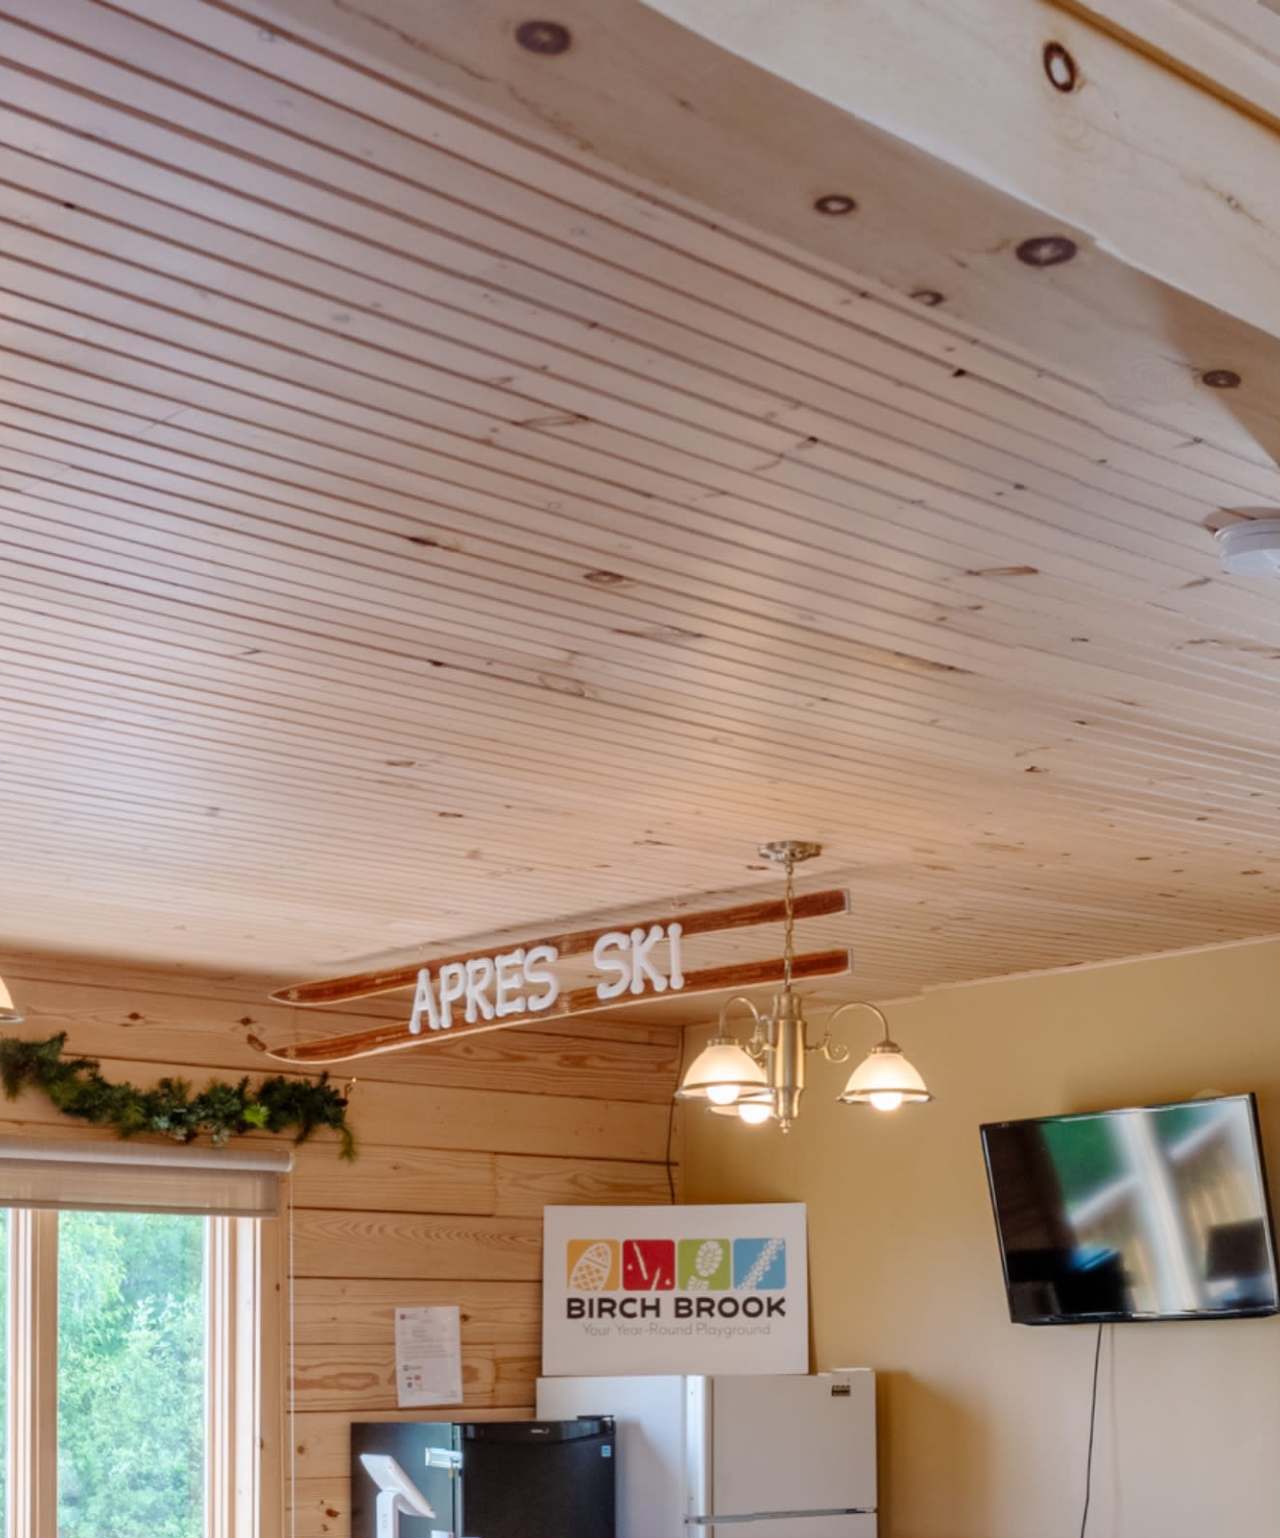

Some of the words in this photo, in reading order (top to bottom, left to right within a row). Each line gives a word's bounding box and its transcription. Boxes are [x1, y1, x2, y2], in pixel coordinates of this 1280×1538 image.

[409, 945, 559, 1034] APRES
[593, 922, 684, 1000] SKI
[566, 1297, 661, 1319] BIRCH
[673, 1296, 786, 1318] BROOK
[582, 1323, 610, 1336] Your
[617, 1323, 693, 1336] Year-Round
[695, 1322, 771, 1338] Playground
